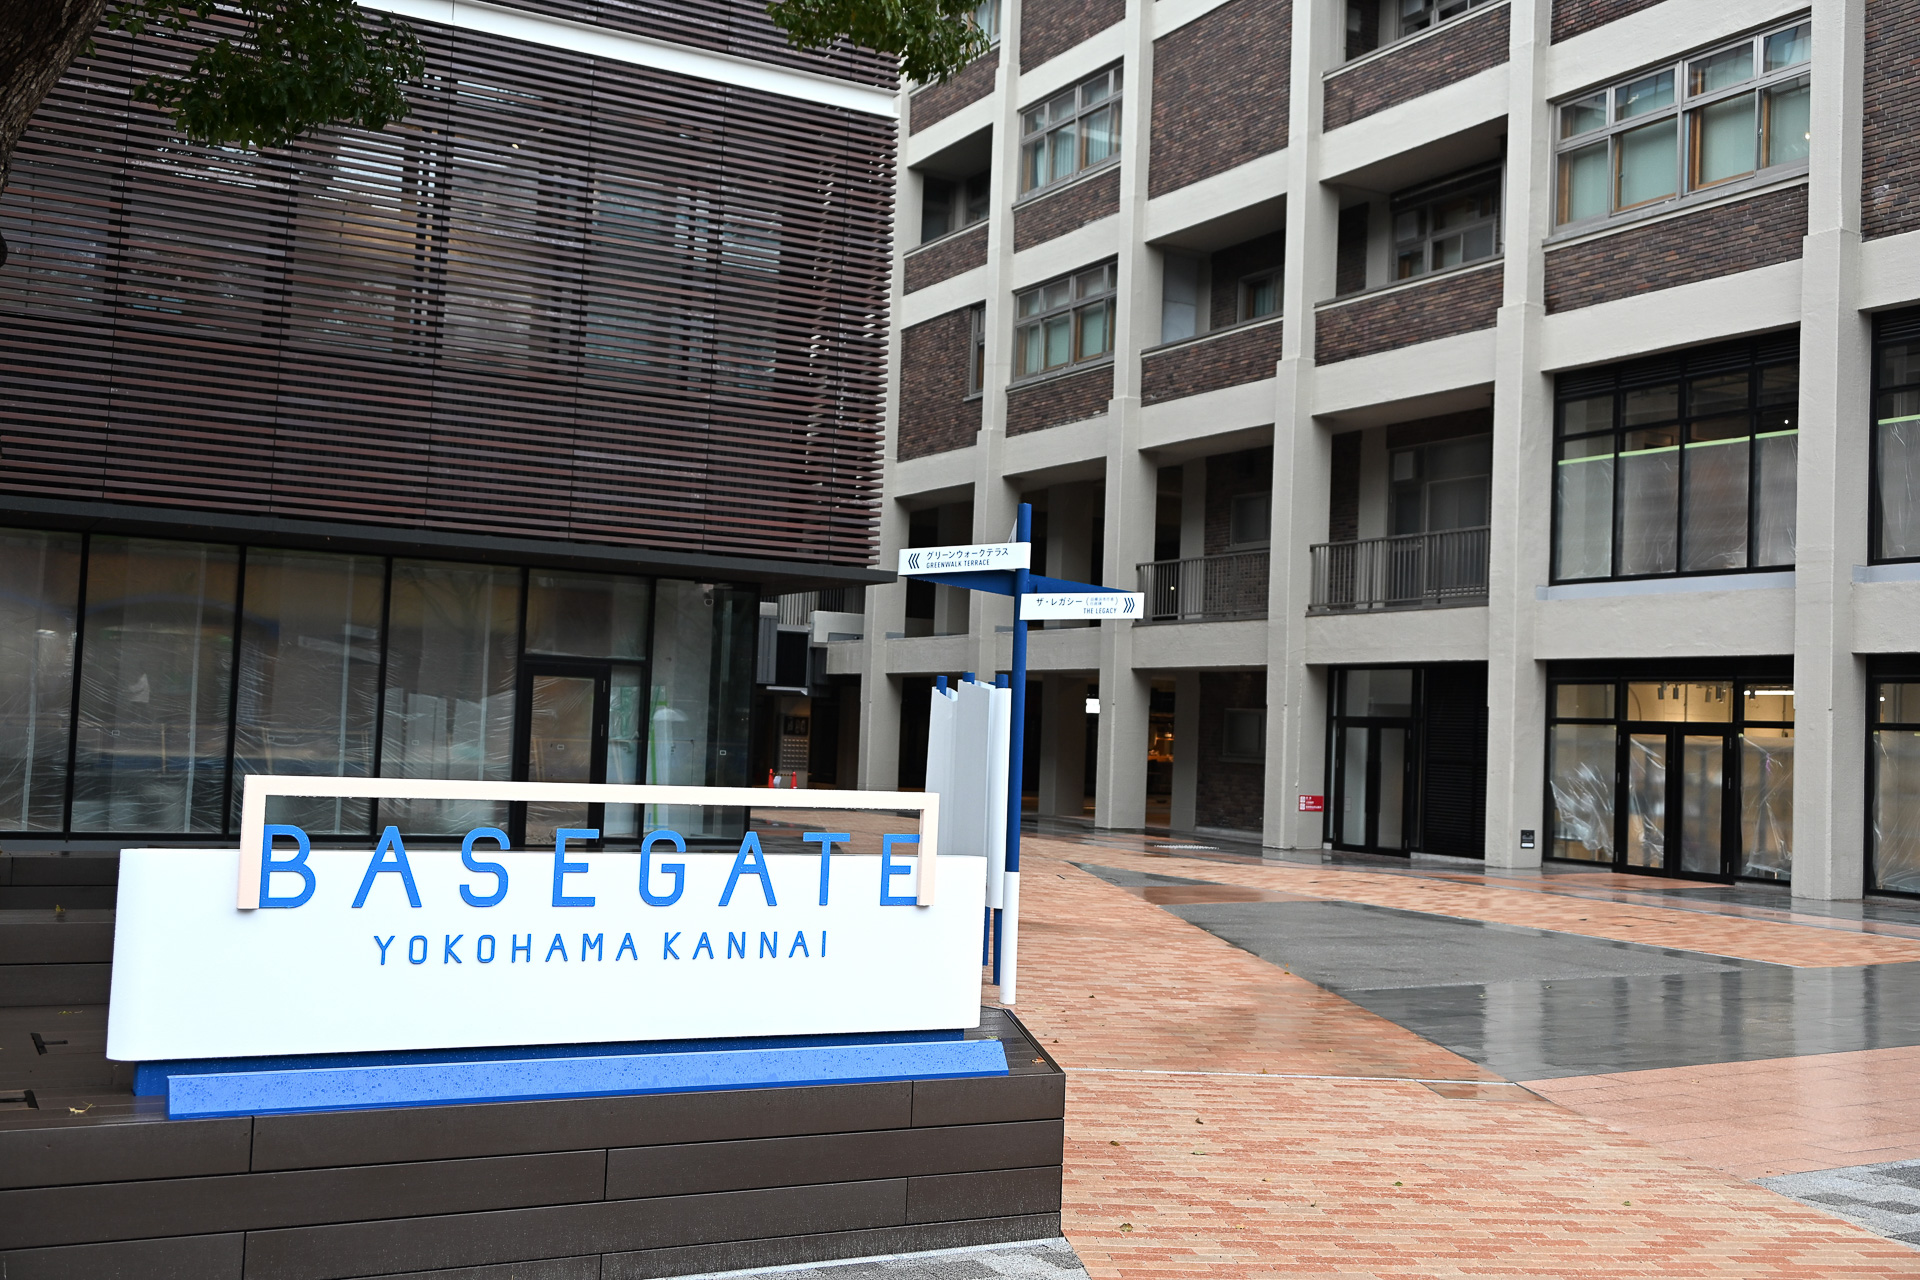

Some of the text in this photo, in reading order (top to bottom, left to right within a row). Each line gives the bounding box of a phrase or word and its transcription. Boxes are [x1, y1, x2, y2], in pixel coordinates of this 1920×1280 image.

[926, 547, 1009, 560] グリーンウォークテラス
[926, 558, 990, 569] GREENWALK TERRACE
[1036, 597, 1083, 606] ザ・レガシー
[258, 823, 921, 909] BASEGATE
[373, 930, 828, 966] YOKOHAMA KANNAI
